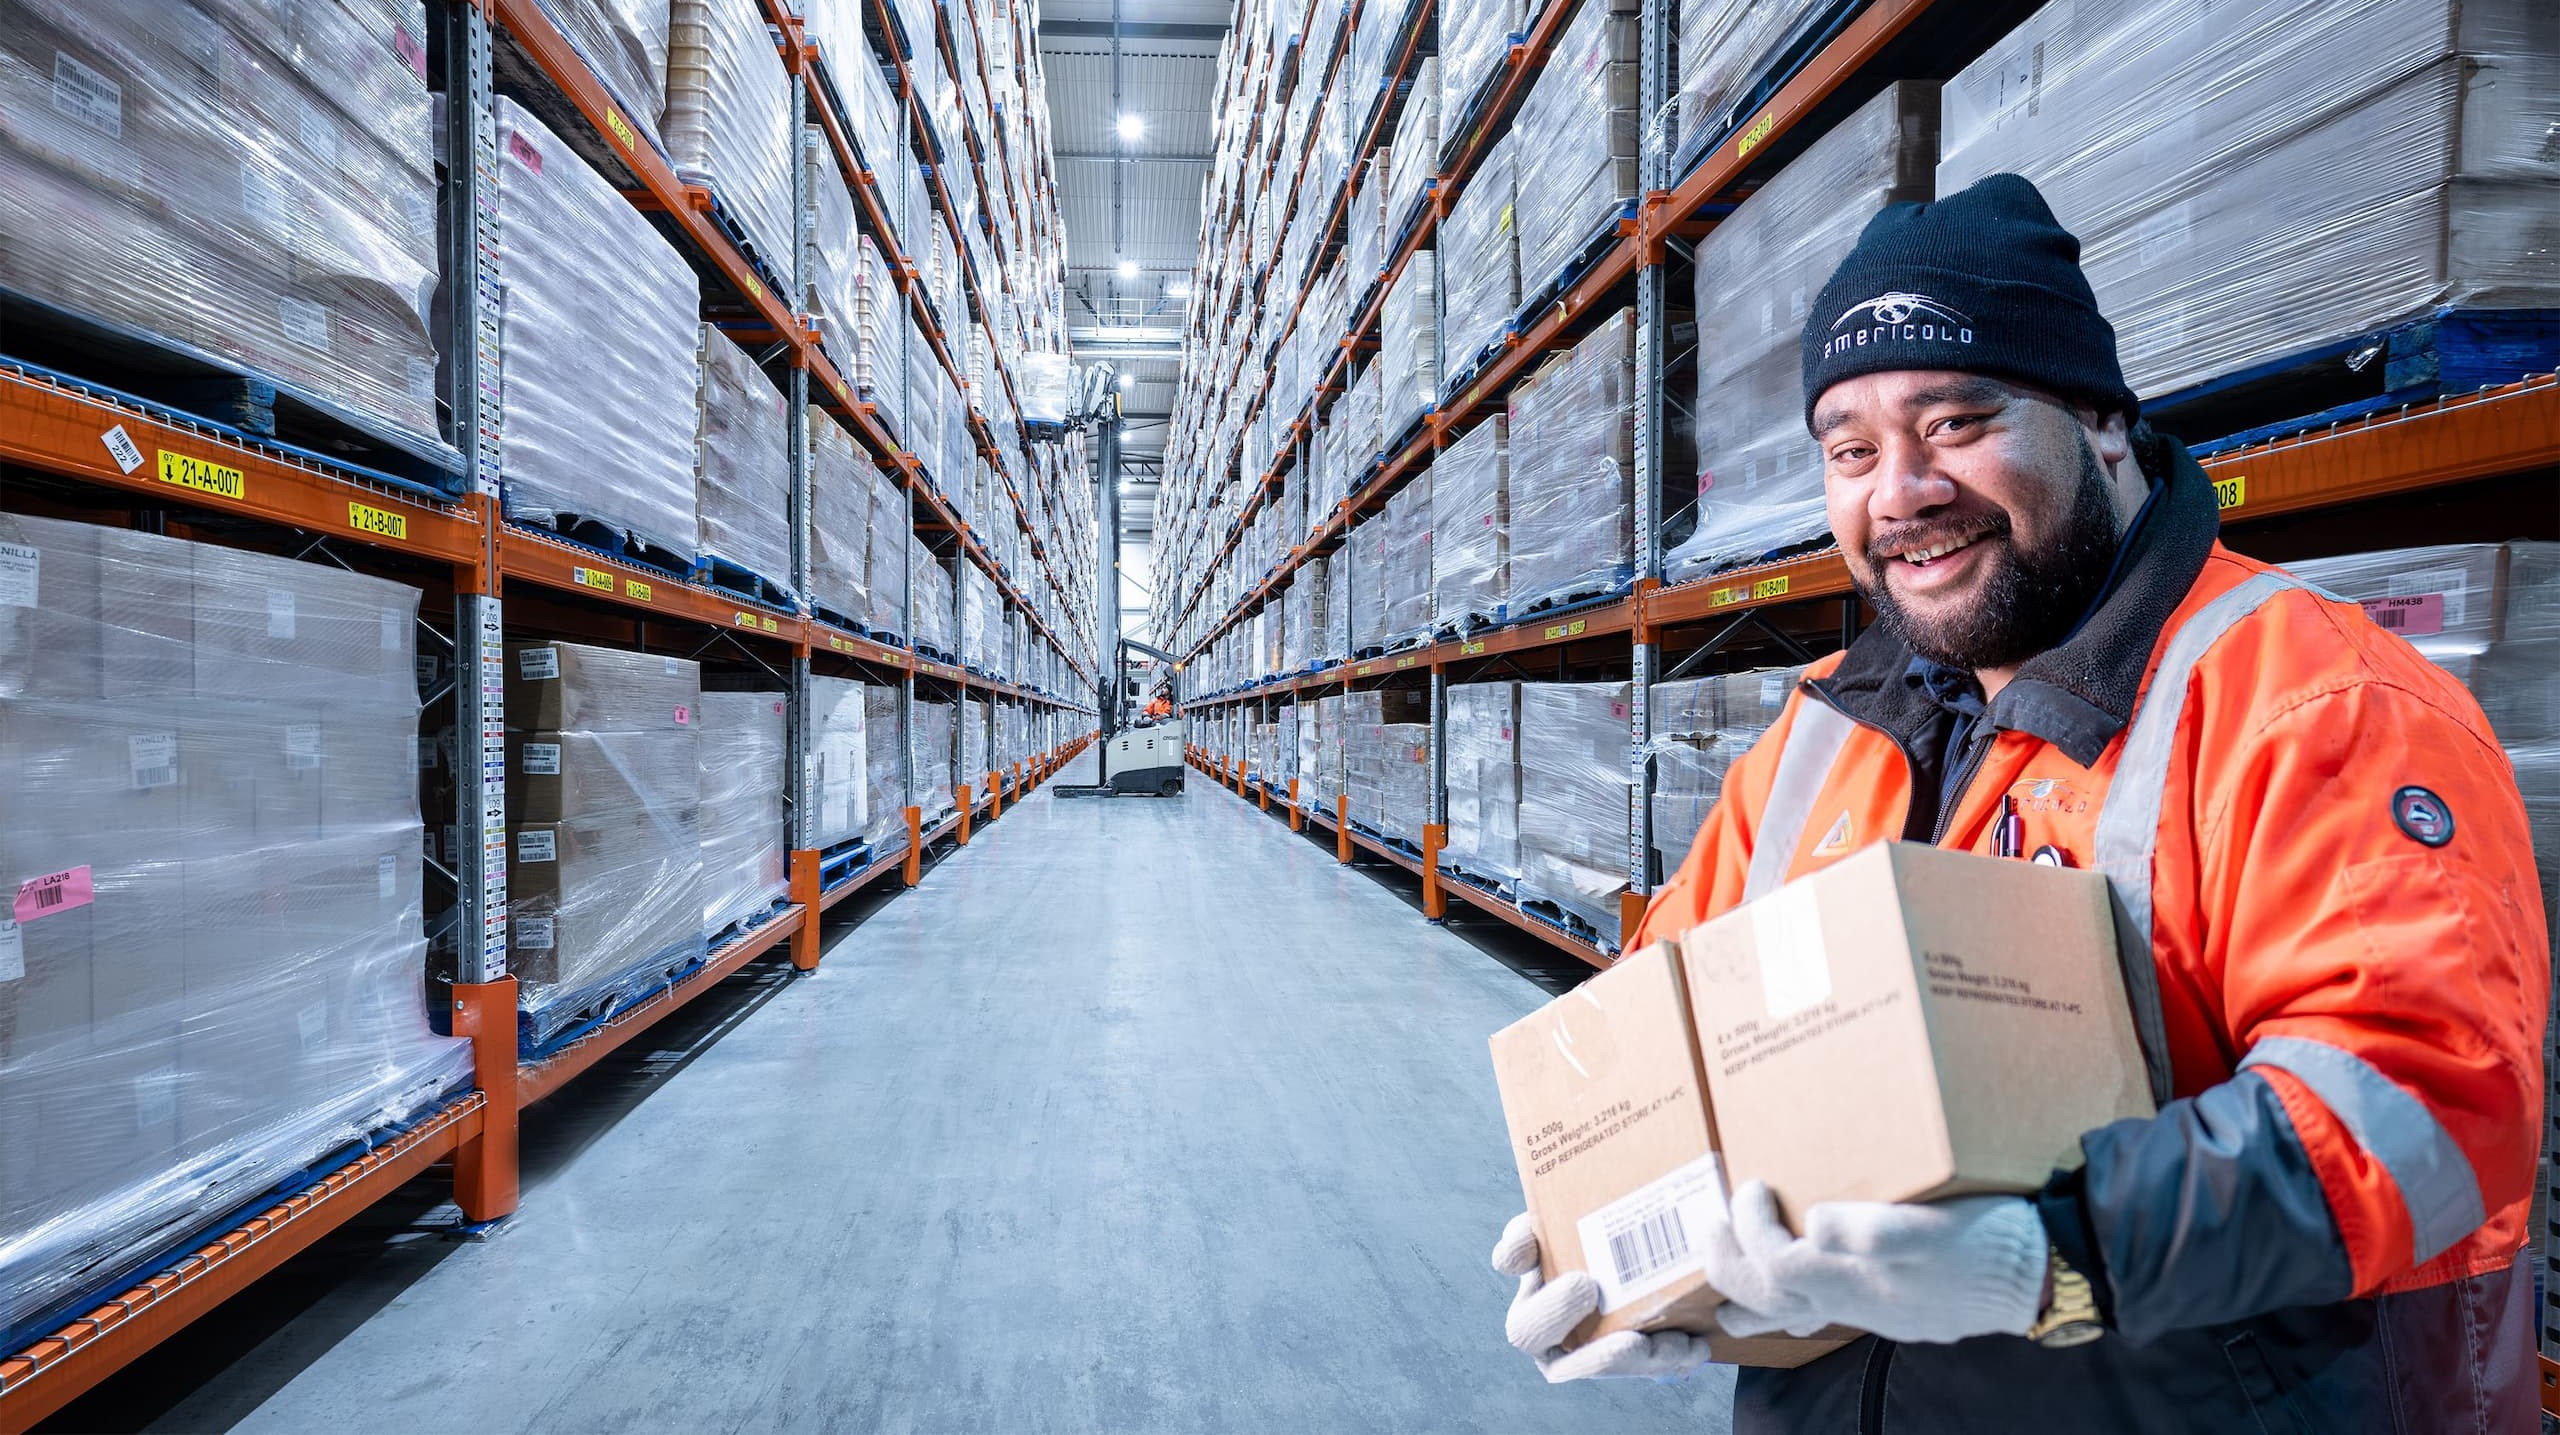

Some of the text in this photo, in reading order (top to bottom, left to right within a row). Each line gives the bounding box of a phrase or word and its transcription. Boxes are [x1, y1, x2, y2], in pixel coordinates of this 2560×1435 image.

[111, 445, 128, 464] 222
[163, 453, 174, 462] 07
[182, 459, 239, 496] 21-A-007
[364, 508, 402, 537] 21-B-007
[1761, 578, 1786, 597] 21-B-010
[2388, 597, 2424, 608] HM438
[2022, 996, 2048, 1009] STORE
[2050, 1001, 2060, 1011] AT
[1722, 1042, 1751, 1060] Gross
[1751, 1025, 1823, 1064] REFRIGERATED
[1526, 1121, 1564, 1146] 6 x 500g
[1531, 1099, 1631, 1162] Gross Weight: 3.216 kg
[1534, 1158, 1557, 1178] KEEP
[1558, 1123, 1621, 1164] REFRIGERATED
[1622, 1106, 1649, 1129] STORE
[1652, 1098, 1663, 1112] AT
